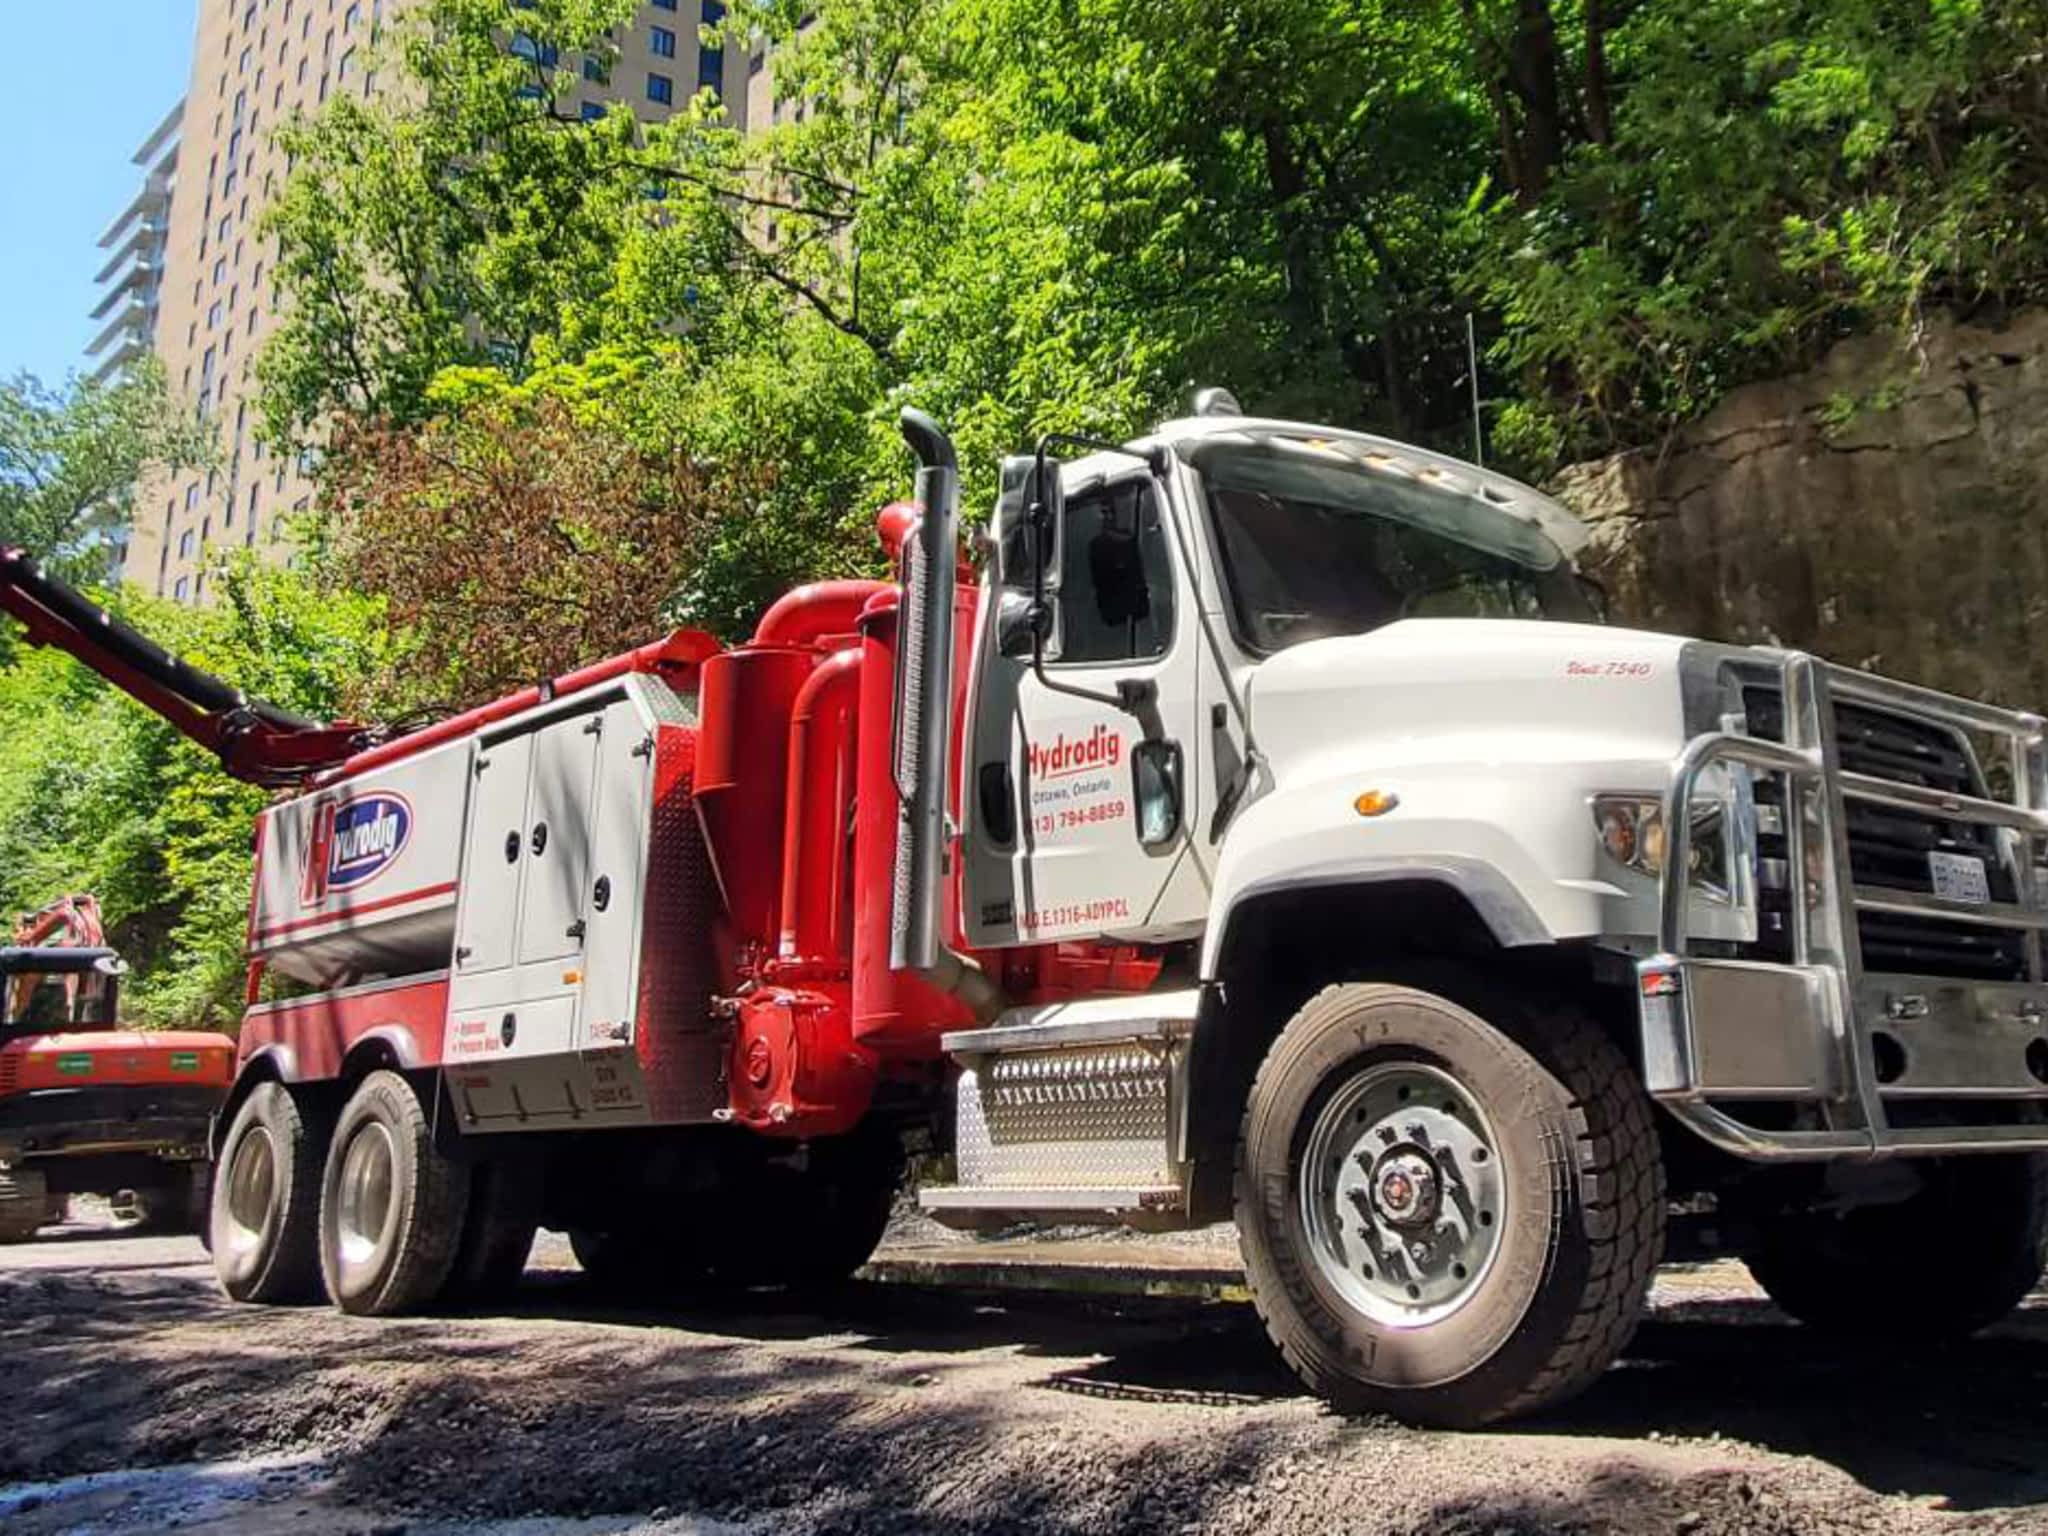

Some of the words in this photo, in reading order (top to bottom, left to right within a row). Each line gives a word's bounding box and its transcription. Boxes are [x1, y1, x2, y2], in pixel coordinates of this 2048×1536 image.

[1605, 660, 1651, 676] 7540
[1024, 723, 1119, 781] Hydrodig
[1072, 779, 1111, 797] Ontario
[1025, 812, 1055, 834] 13)
[300, 800, 399, 907] Hydrodig
